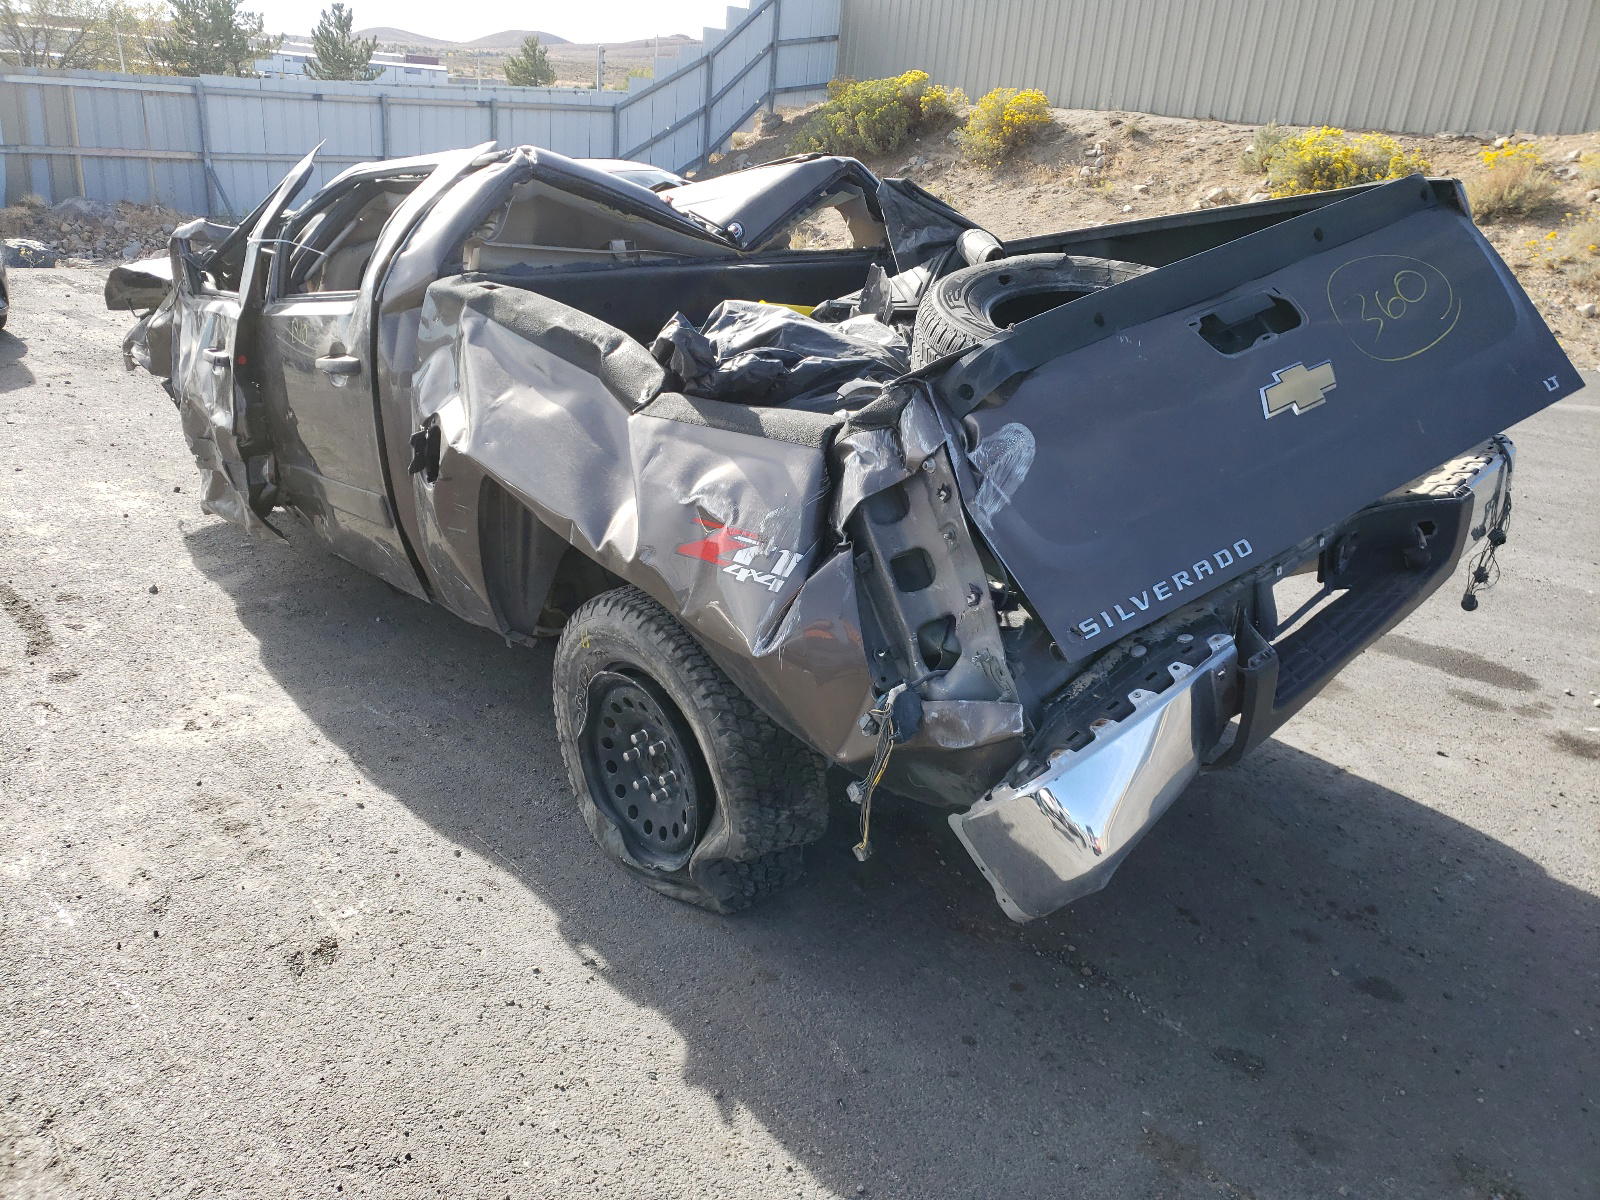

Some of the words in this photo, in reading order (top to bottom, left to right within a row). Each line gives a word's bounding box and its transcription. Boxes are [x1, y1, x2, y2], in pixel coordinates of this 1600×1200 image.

[1345, 269, 1427, 343] 360
[1542, 375, 1560, 392] LT
[1078, 538, 1253, 640] SILVERADO
